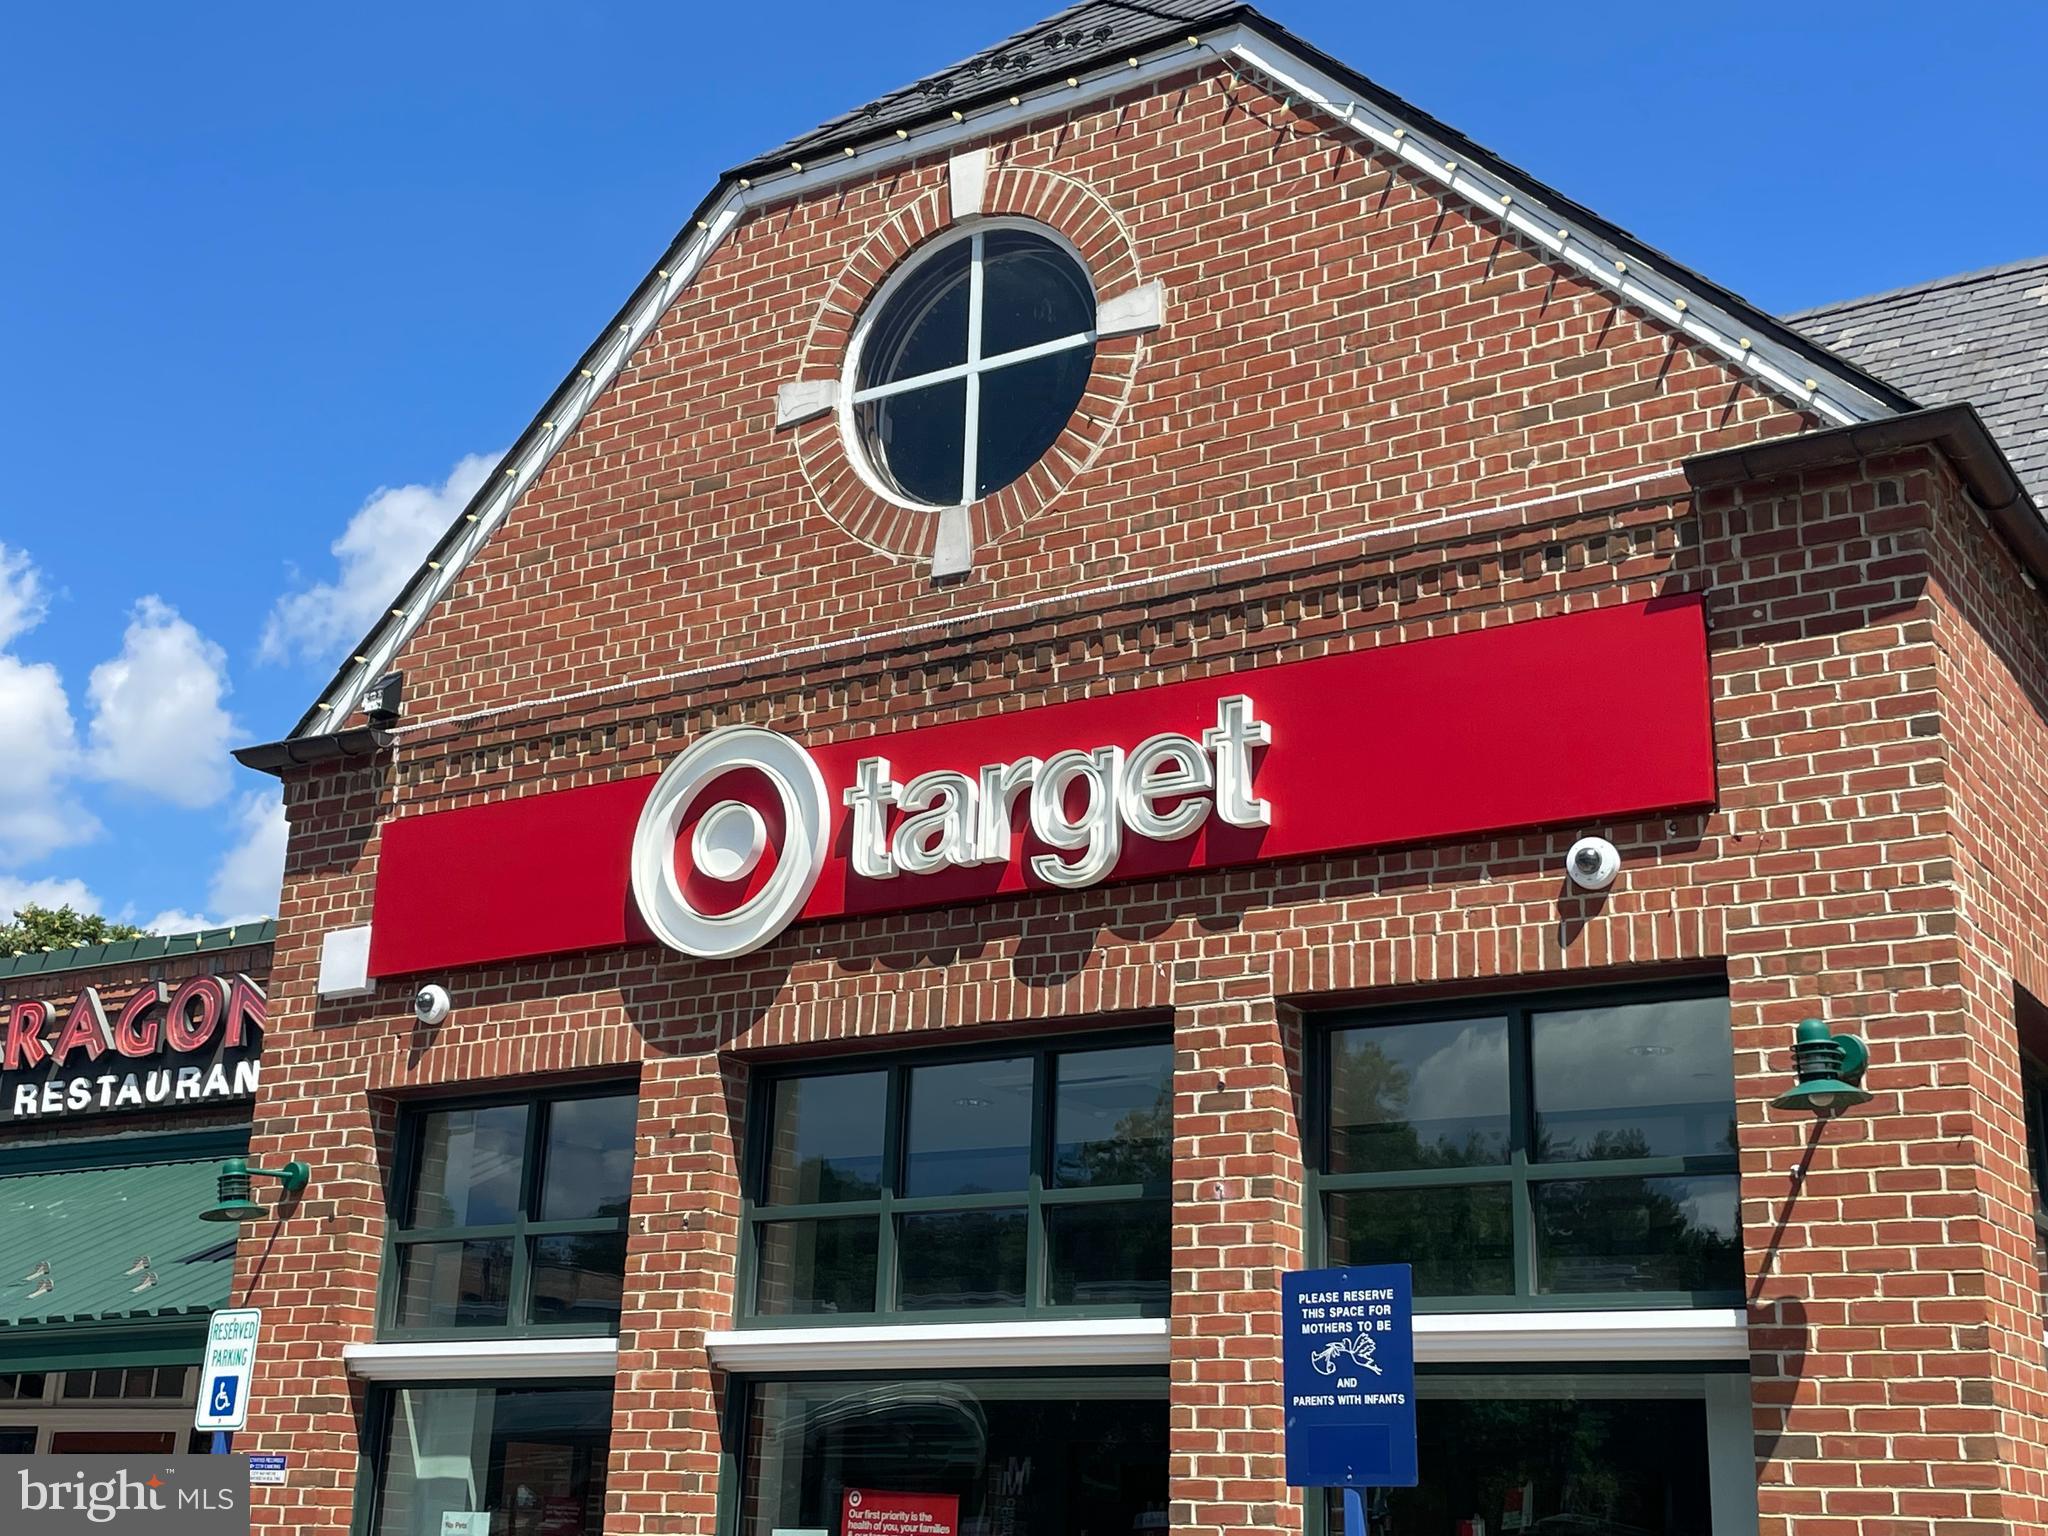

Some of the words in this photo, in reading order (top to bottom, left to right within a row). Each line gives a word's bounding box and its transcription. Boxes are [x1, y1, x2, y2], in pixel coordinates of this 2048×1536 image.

[843, 694, 1272, 889] target
[0, 972, 267, 1070] RAGON
[1298, 1292, 1340, 1304] PLEASE
[1343, 1289, 1394, 1302] RESERVE
[1301, 1308, 1325, 1319] THIS
[1329, 1306, 1365, 1318] SPACE
[1369, 1304, 1392, 1316] FOR
[211, 1321, 256, 1341] RESERVED
[1301, 1322, 1353, 1334] MOTHERS
[1357, 1321, 1373, 1332] TO
[1376, 1320, 1392, 1331] BE
[211, 1348, 248, 1367] PARKING
[1336, 1378, 1358, 1388] AND
[1293, 1395, 1335, 1407] PARENTS
[1337, 1394, 1362, 1405] WITH
[1364, 1393, 1405, 1405] INFANTS
[848, 1509, 864, 1519] Our
[864, 1509, 881, 1519] first
[881, 1510, 910, 1523] priority
[911, 1511, 918, 1522] is
[919, 1511, 933, 1522] the
[847, 1519, 873, 1531] health
[873, 1521, 883, 1530] of
[900, 1524, 919, 1534] your
[919, 1523, 951, 1534] families
